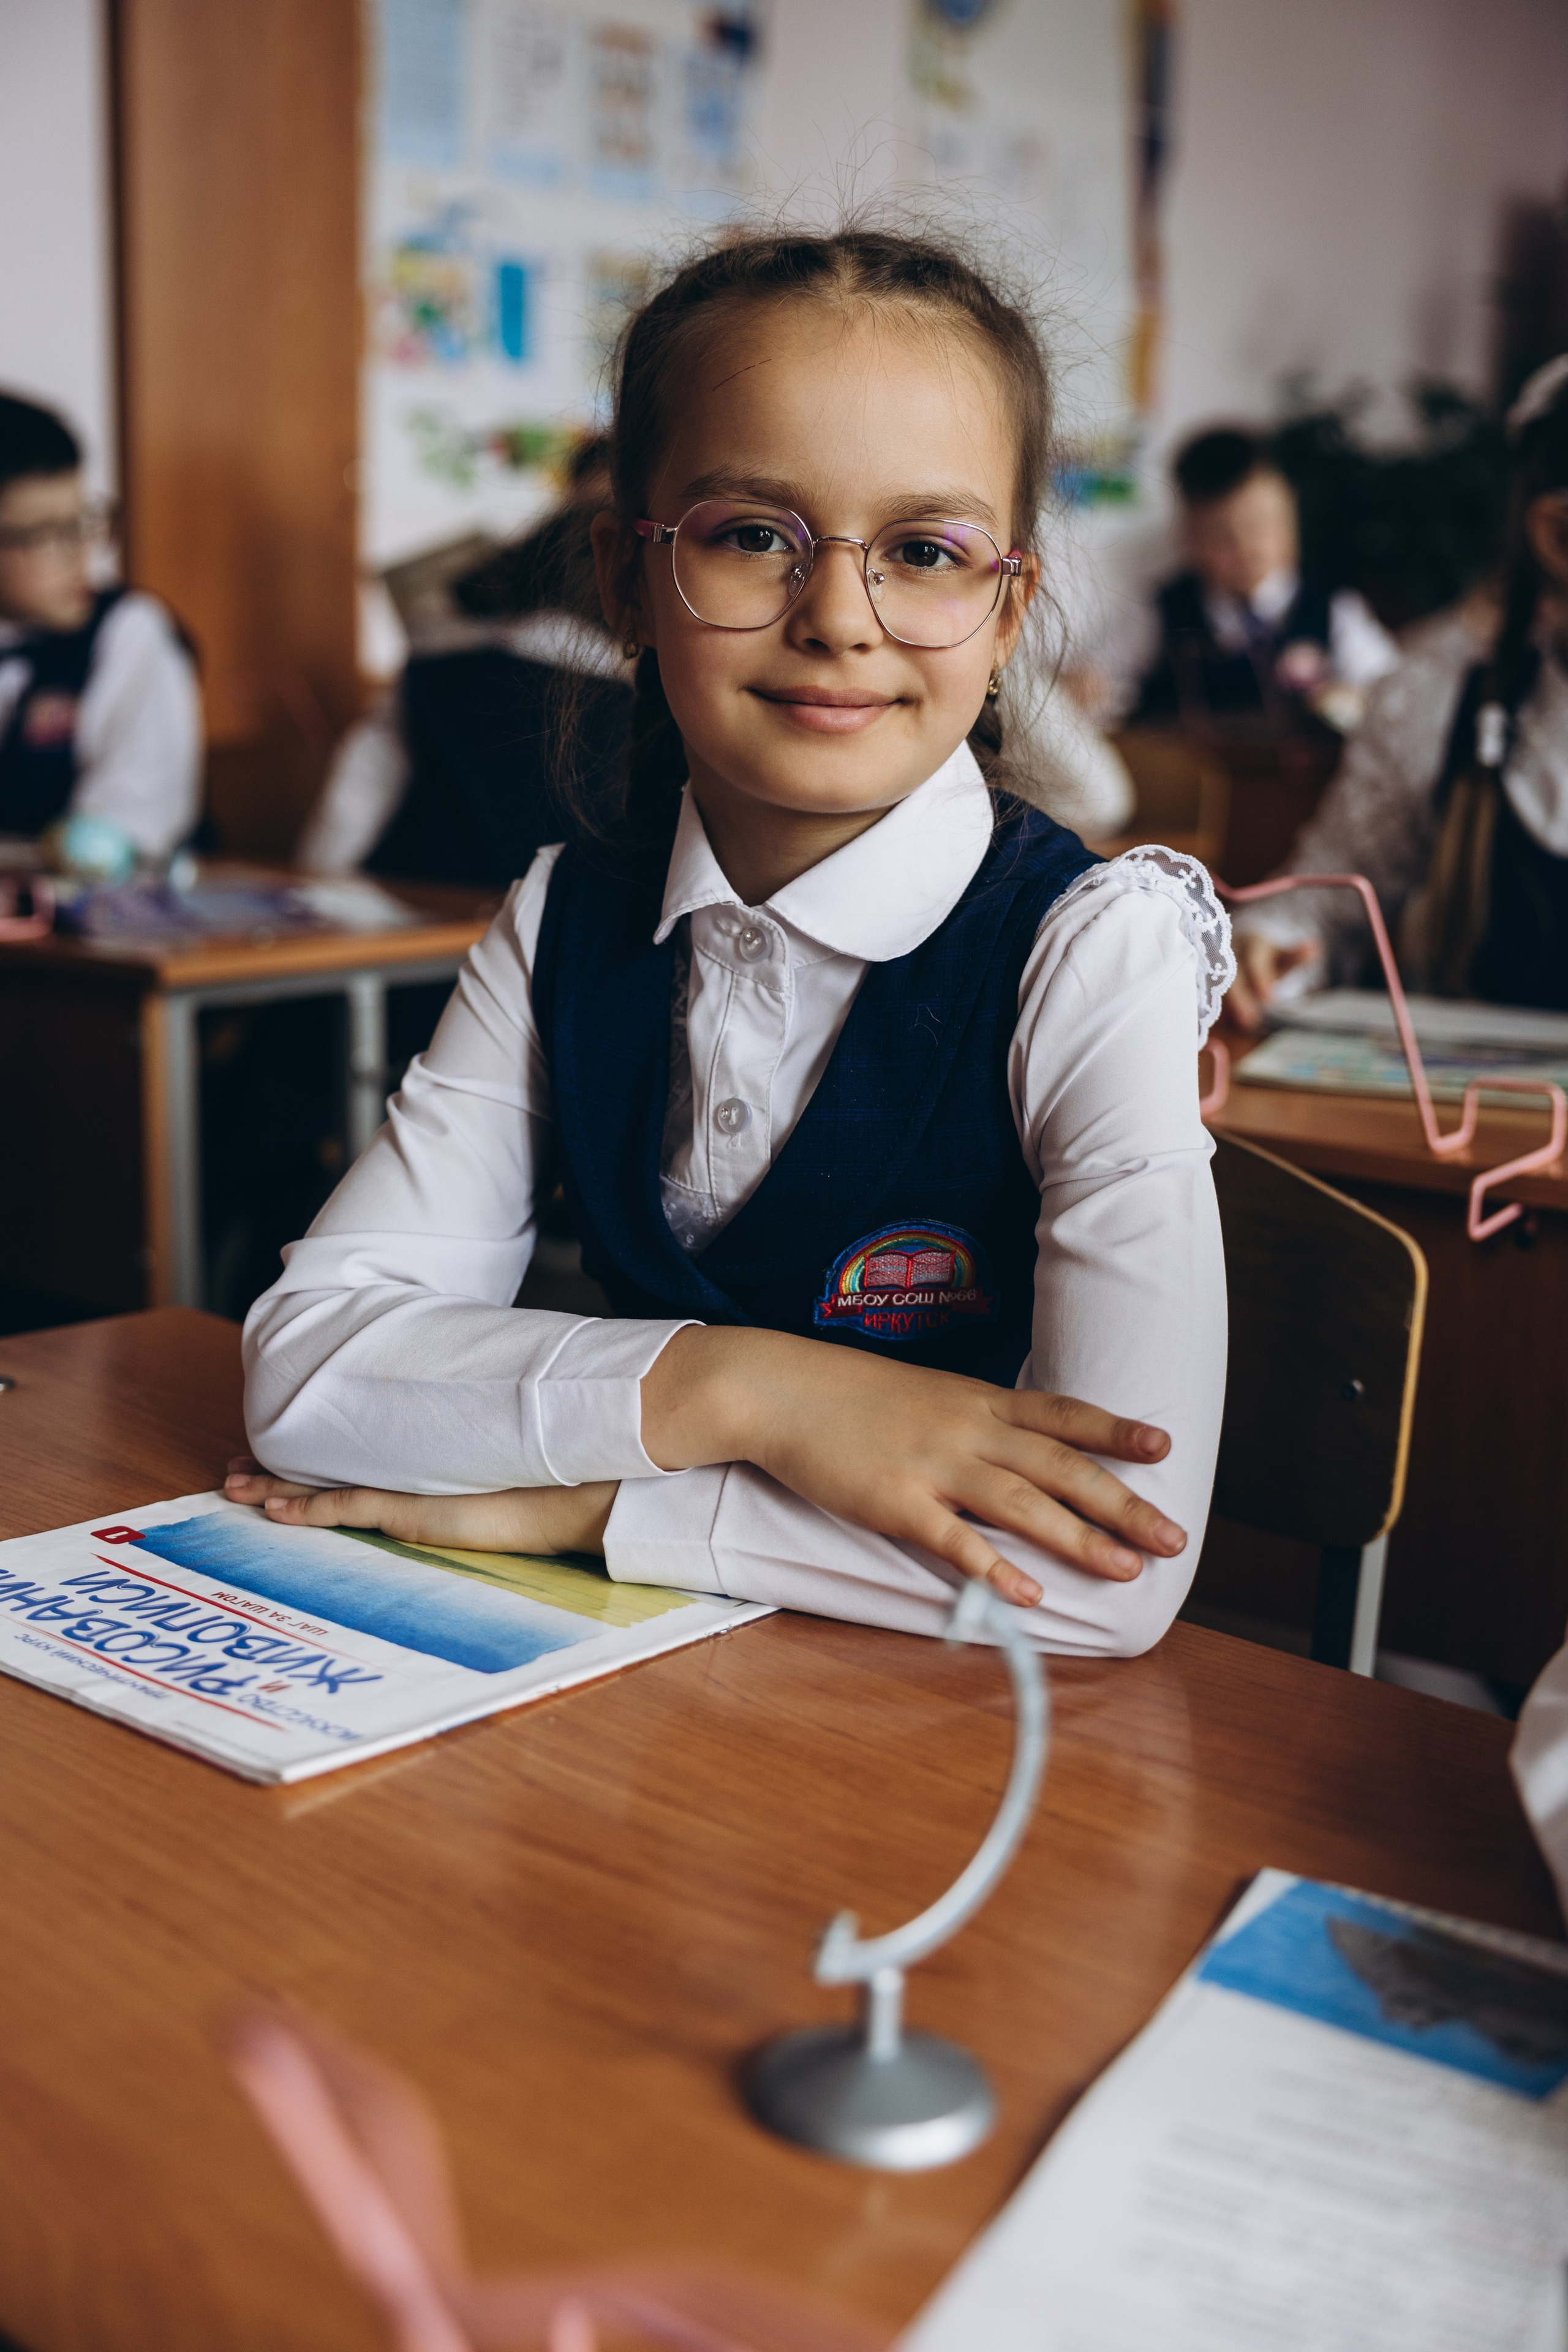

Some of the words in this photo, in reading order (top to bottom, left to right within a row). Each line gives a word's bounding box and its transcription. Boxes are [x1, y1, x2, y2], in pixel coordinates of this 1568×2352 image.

[837, 1294, 889, 1307] МБОУ
[892, 1292, 934, 1306] СОШ
[863, 1311, 950, 1333] ИРКУТСК
[104, 1531, 129, 1539] 1
[211, 1591, 270, 1614] ШАГОМ
[268, 1611, 292, 1622] ЗА
[0, 1569, 260, 1695] РИСОВАНИ
[59, 1570, 384, 1694] ЖИВОПИСИ
[287, 1621, 330, 1636] ШАГ
[13, 1633, 56, 1652] КУРС
[257, 1680, 292, 1694] И
